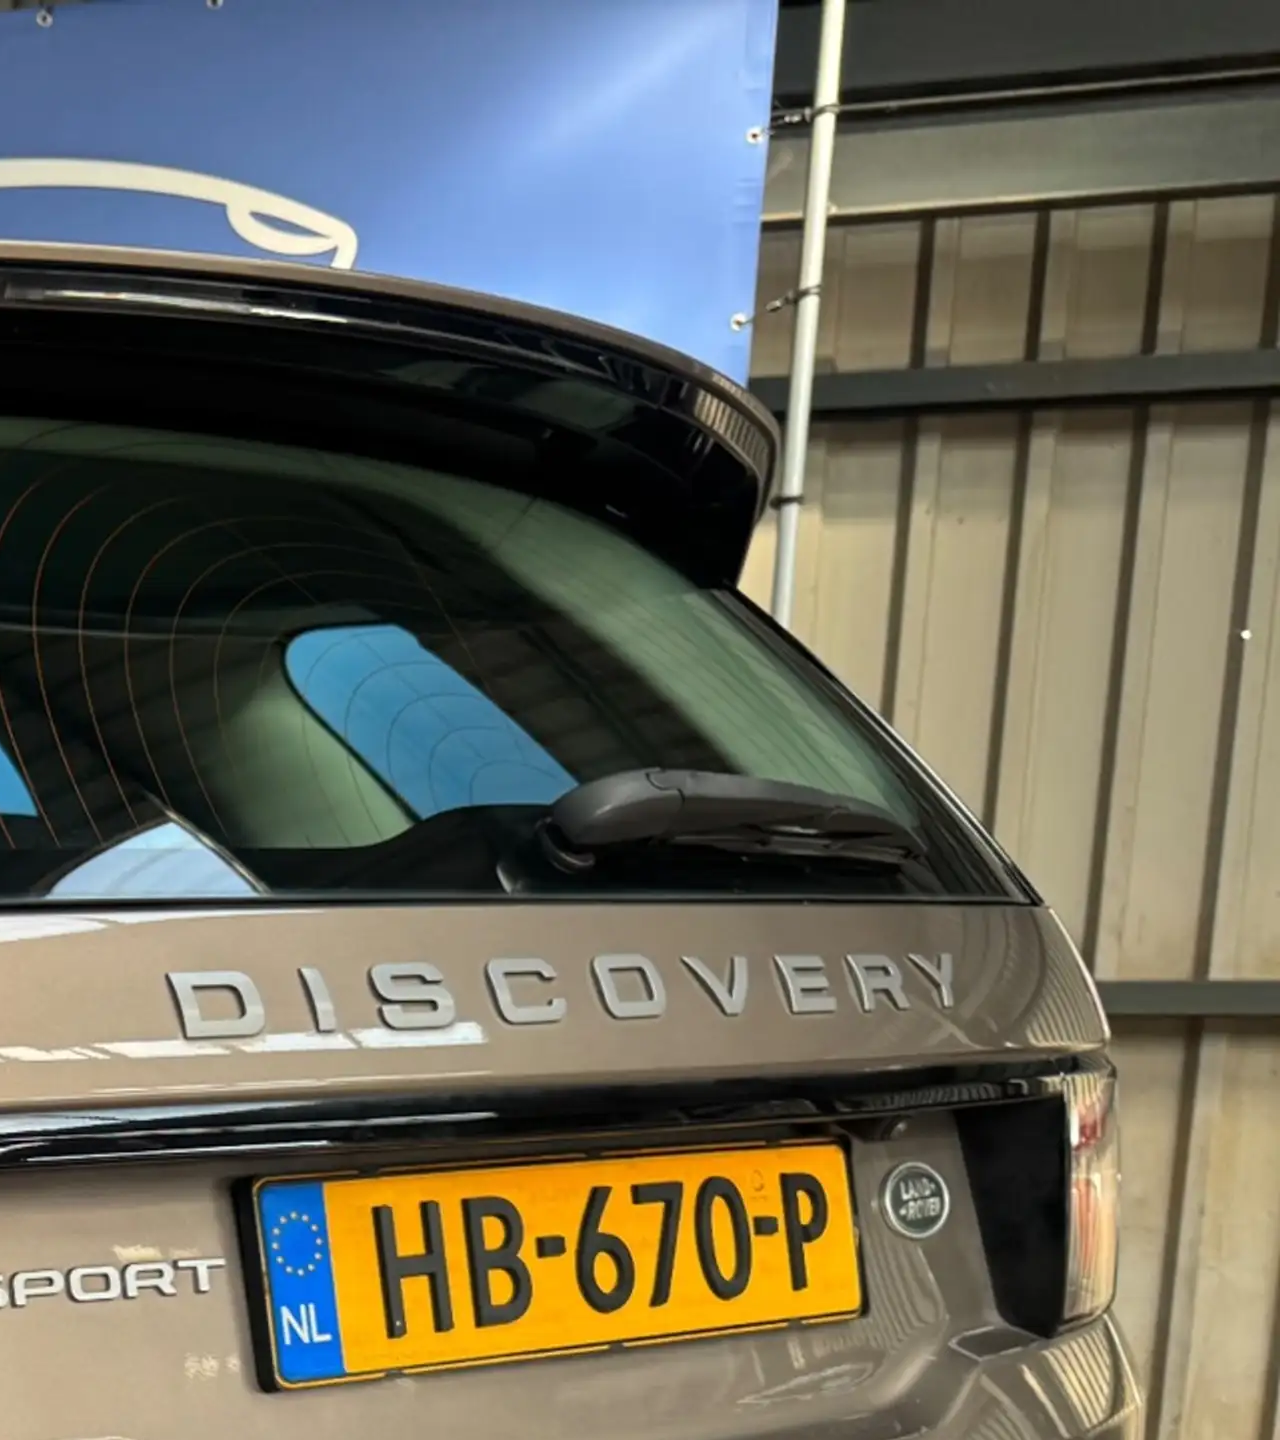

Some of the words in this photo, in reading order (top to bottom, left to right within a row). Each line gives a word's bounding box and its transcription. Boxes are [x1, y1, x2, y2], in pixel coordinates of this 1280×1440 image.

[167, 952, 954, 1042] DISCOVERY
[371, 1171, 829, 1340] HB-670-P
[280, 1303, 332, 1346] NL
